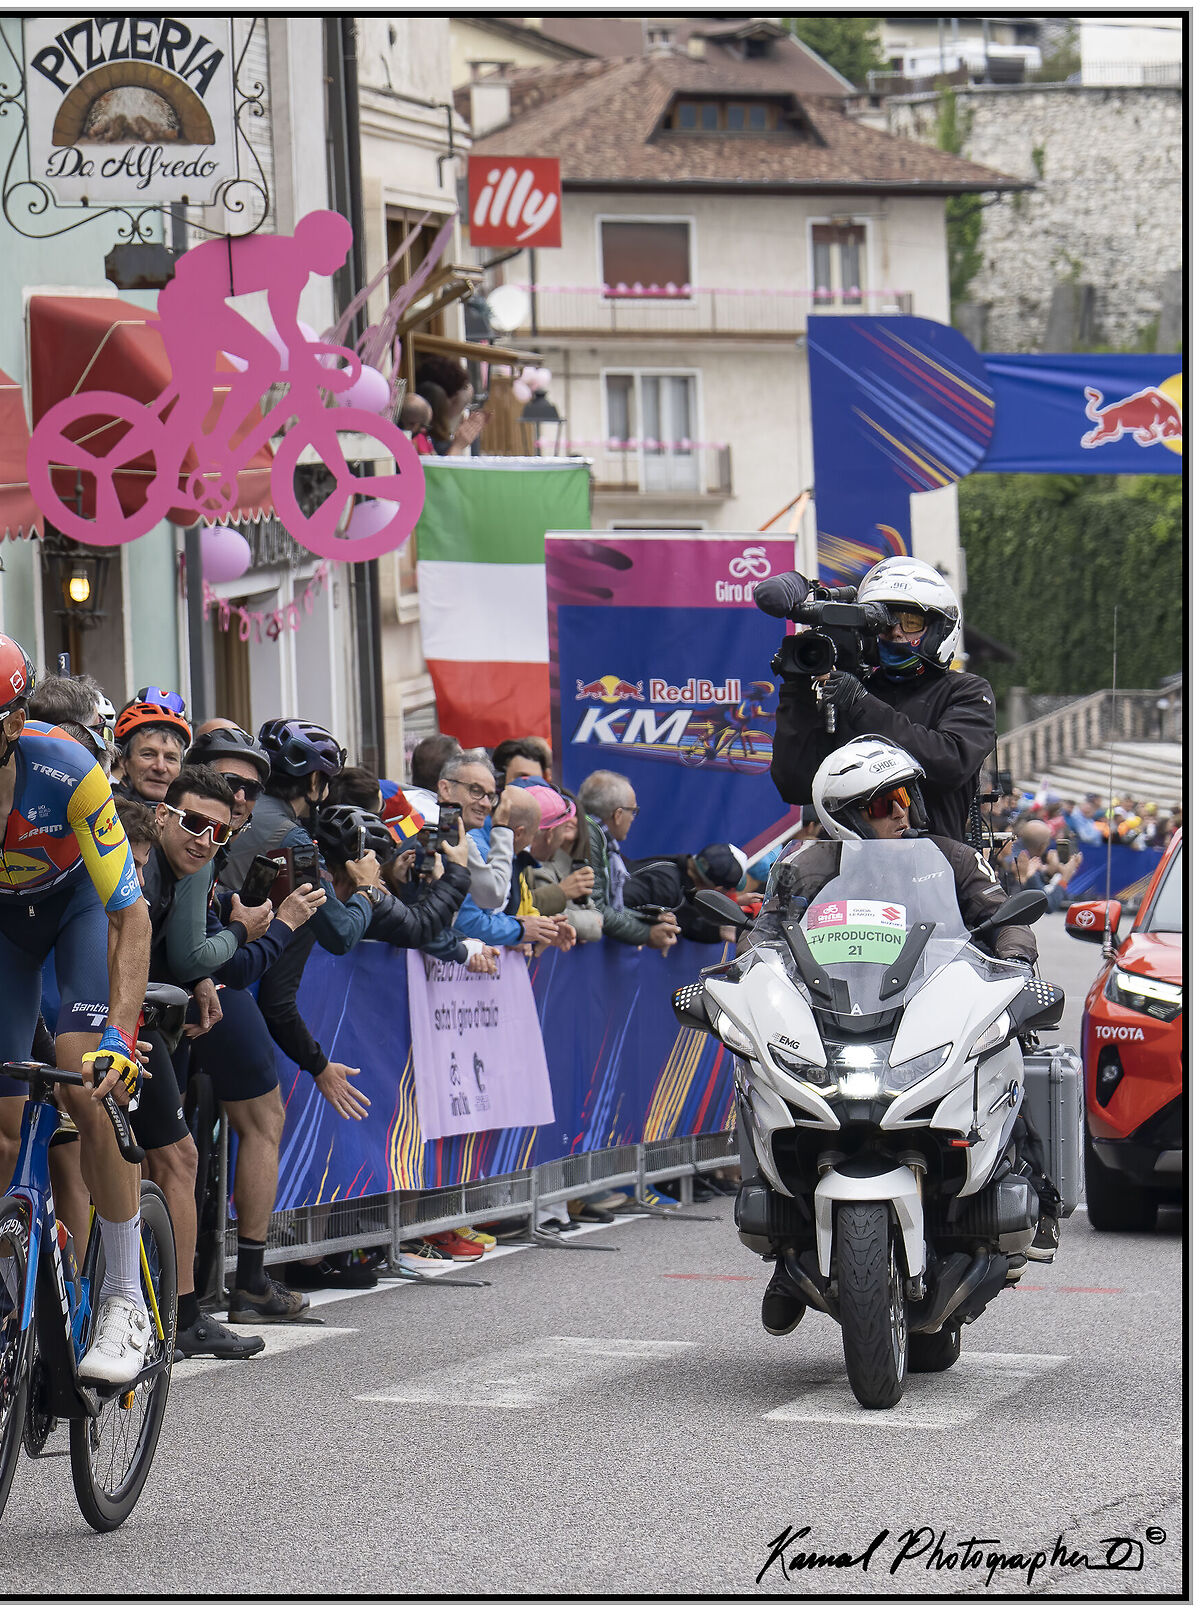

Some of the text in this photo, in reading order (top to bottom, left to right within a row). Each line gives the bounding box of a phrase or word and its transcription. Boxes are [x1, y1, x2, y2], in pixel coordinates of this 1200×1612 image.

[31, 18, 224, 98] PIZZERIA
[46, 145, 219, 189] Da Alfredo
[473, 166, 557, 241] illy
[716, 580, 743, 602] Giro
[650, 679, 742, 704] Red Bull
[573, 706, 694, 745] KM
[32, 761, 79, 787] TREK
[18, 824, 63, 842] SRAM
[811, 931, 902, 945] TV PRODUCTION
[848, 945, 863, 956] 21
[779, 1035, 801, 1050] EMG
[1095, 1025, 1145, 1041] TOYOTA
